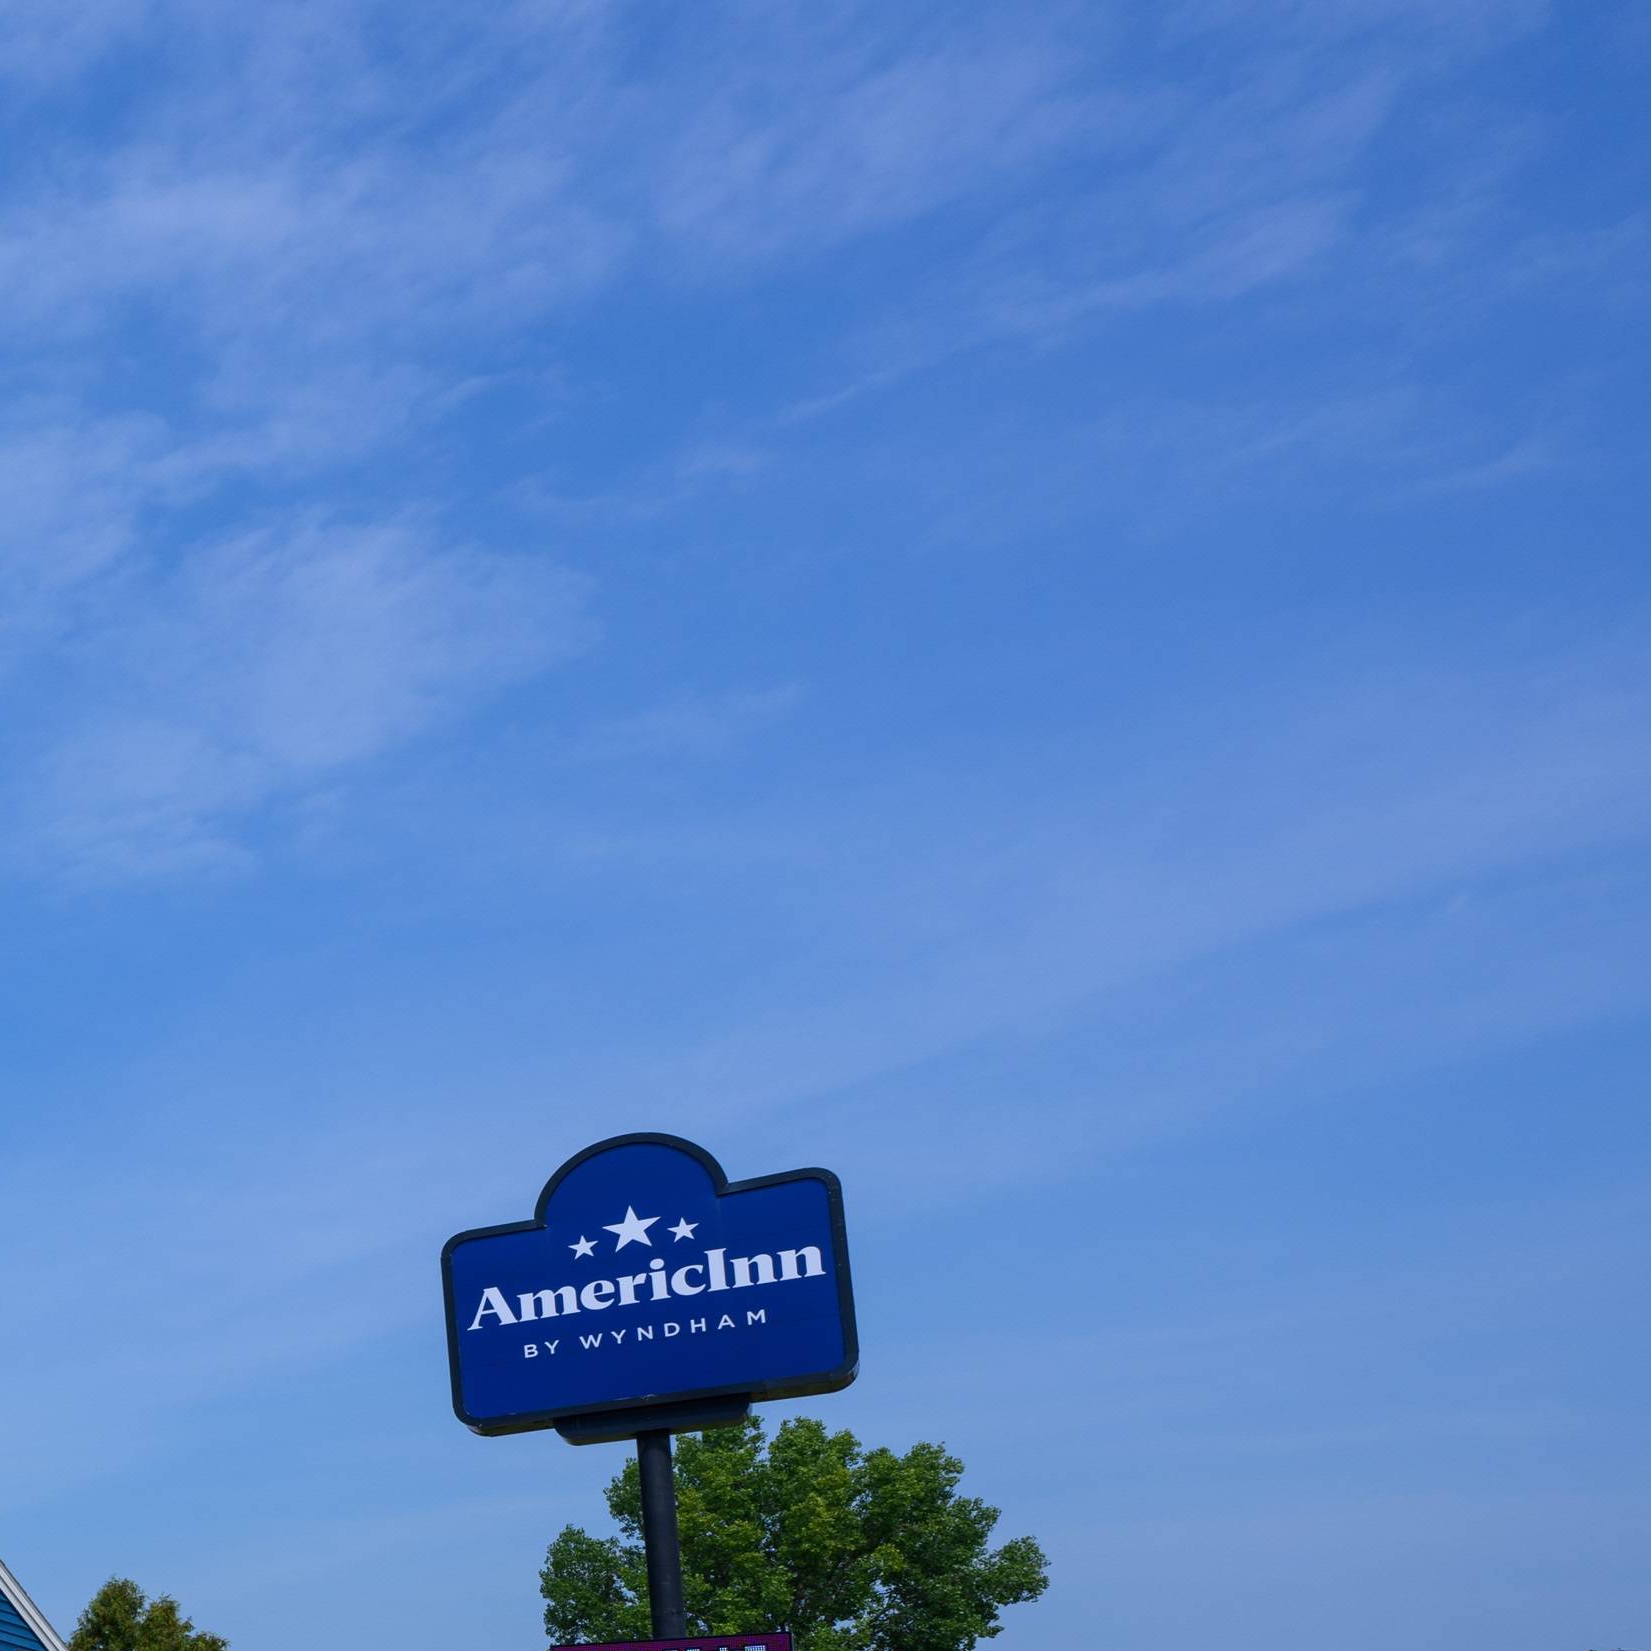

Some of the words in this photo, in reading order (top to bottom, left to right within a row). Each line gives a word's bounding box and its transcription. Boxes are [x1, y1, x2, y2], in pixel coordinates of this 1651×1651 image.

[466, 1245, 827, 1331] AmericInn
[523, 1339, 561, 1359] BY
[579, 1308, 768, 1350] WYNDHAM
